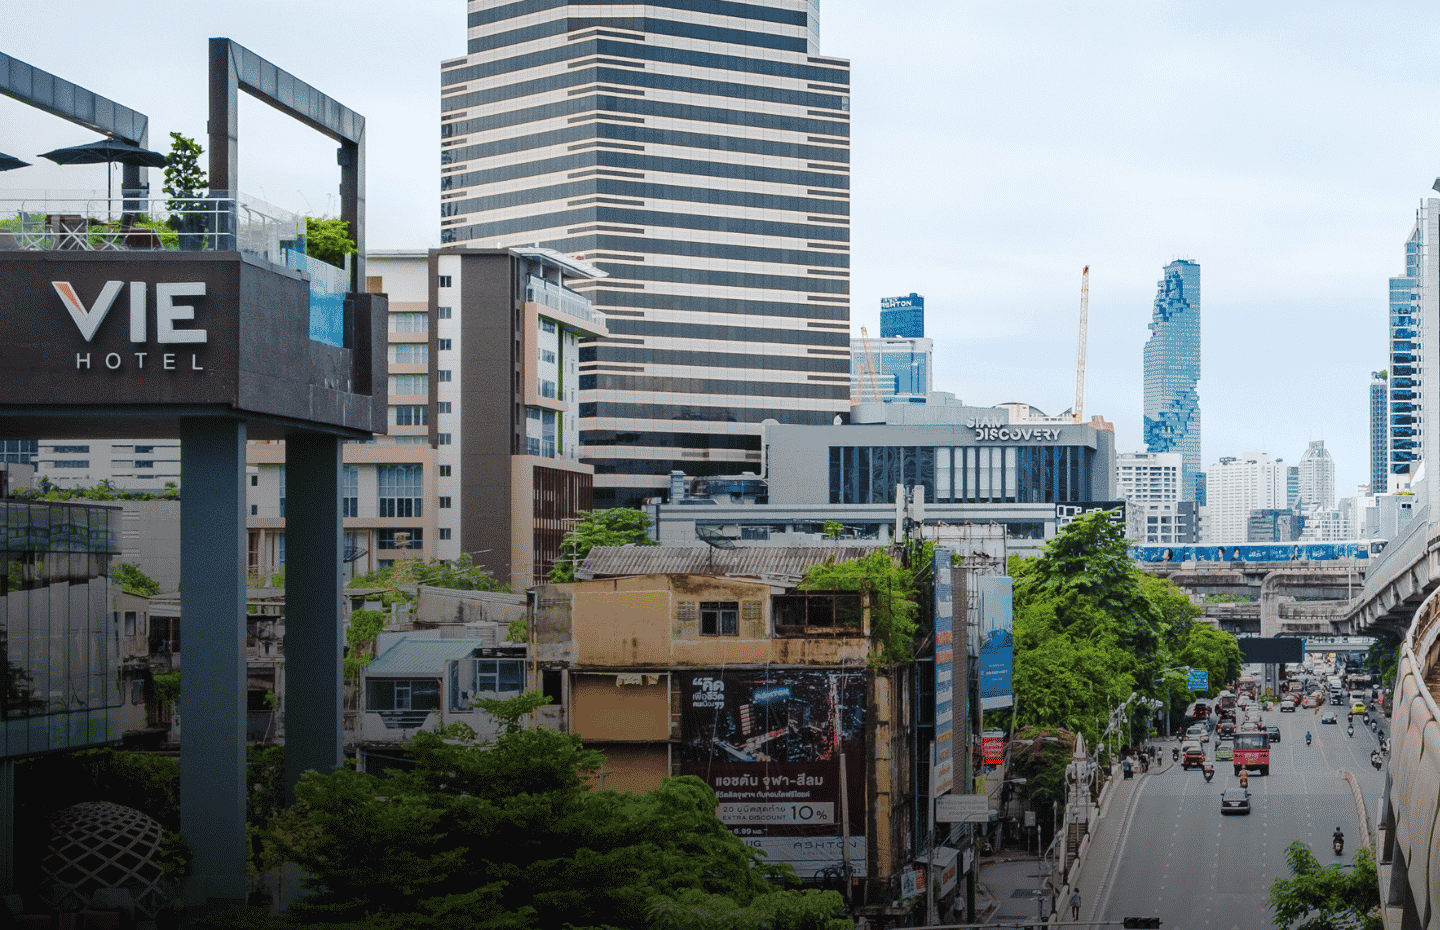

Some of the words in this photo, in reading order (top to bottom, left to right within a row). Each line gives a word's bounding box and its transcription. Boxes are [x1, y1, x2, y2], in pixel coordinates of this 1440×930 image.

[51, 280, 208, 344] VIE
[76, 352, 204, 370] HOTEL
[965, 416, 1005, 429] SIAM
[975, 428, 1062, 441] DISCOVERY
[715, 773, 759, 787] แอชตัน
[762, 772, 824, 790] จุฬา-สีลม
[790, 805, 814, 821] 10
[816, 810, 828, 820] %
